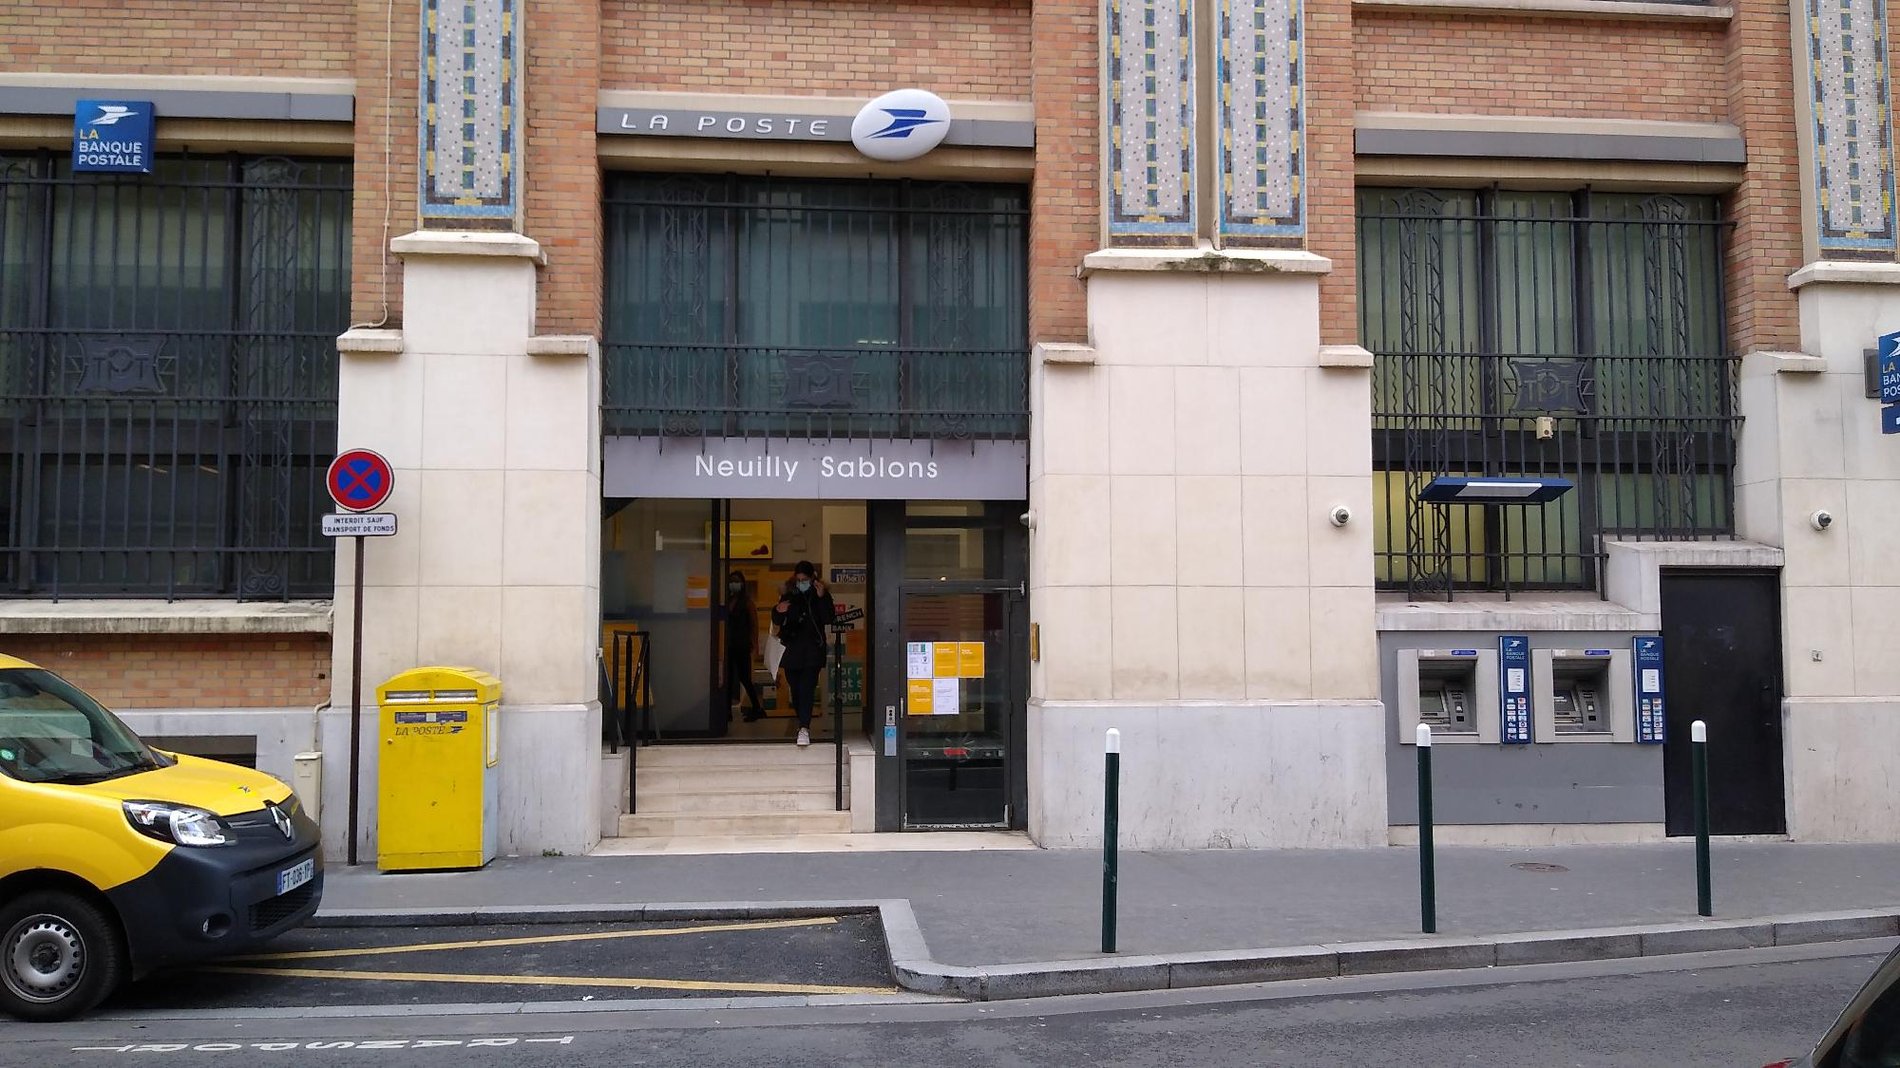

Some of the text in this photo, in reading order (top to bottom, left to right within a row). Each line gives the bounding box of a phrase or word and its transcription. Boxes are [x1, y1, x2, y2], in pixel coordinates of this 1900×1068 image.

[621, 113, 828, 135] LA POSTE
[80, 129, 99, 140] LA
[80, 141, 142, 154] BANQUE
[78, 154, 141, 166] POSTALE
[1882, 362, 1896, 374] LA
[695, 455, 938, 482] Neuilly Sablons
[395, 726, 446, 736] LA POSTE
[72, 1035, 574, 1053] TRANSPORT
